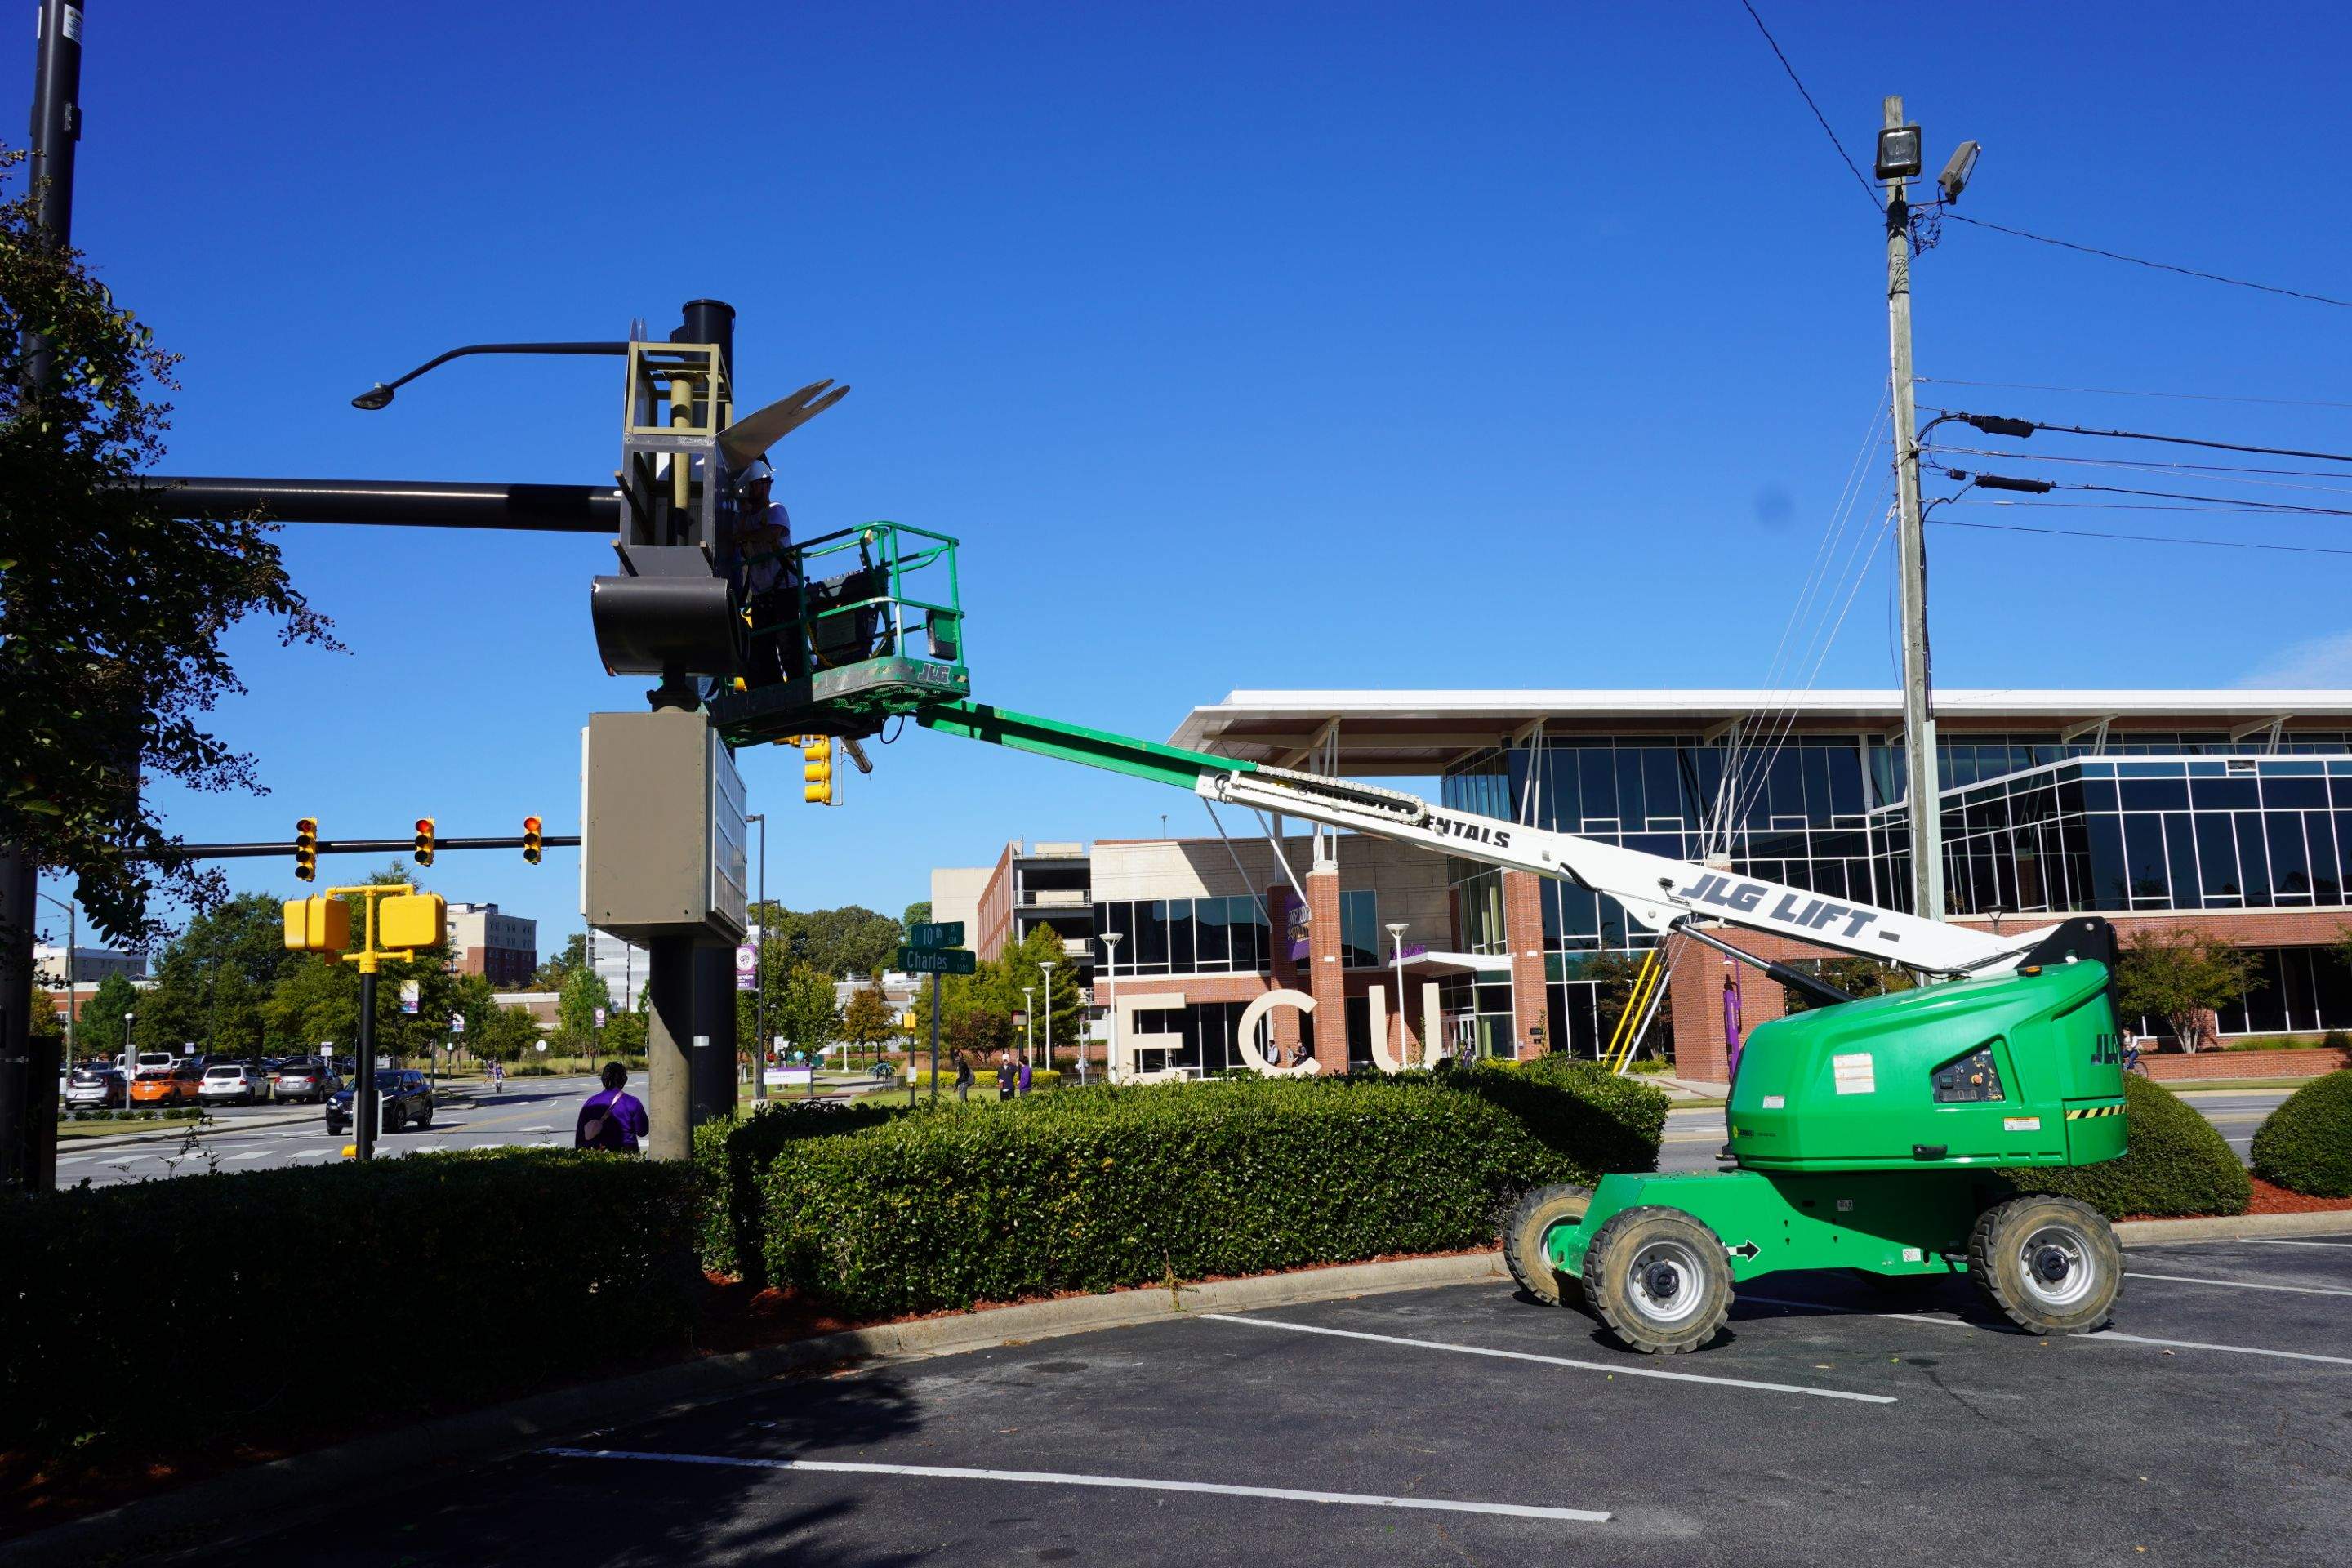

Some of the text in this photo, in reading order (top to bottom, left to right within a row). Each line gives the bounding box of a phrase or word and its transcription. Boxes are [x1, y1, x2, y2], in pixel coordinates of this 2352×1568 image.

[917, 662, 951, 684] JLG
[1422, 814, 1512, 849] ENTALS
[1678, 873, 1878, 938] JLG LIFT
[906, 951, 947, 970] Charles
[1116, 982, 1442, 1085] ECU
